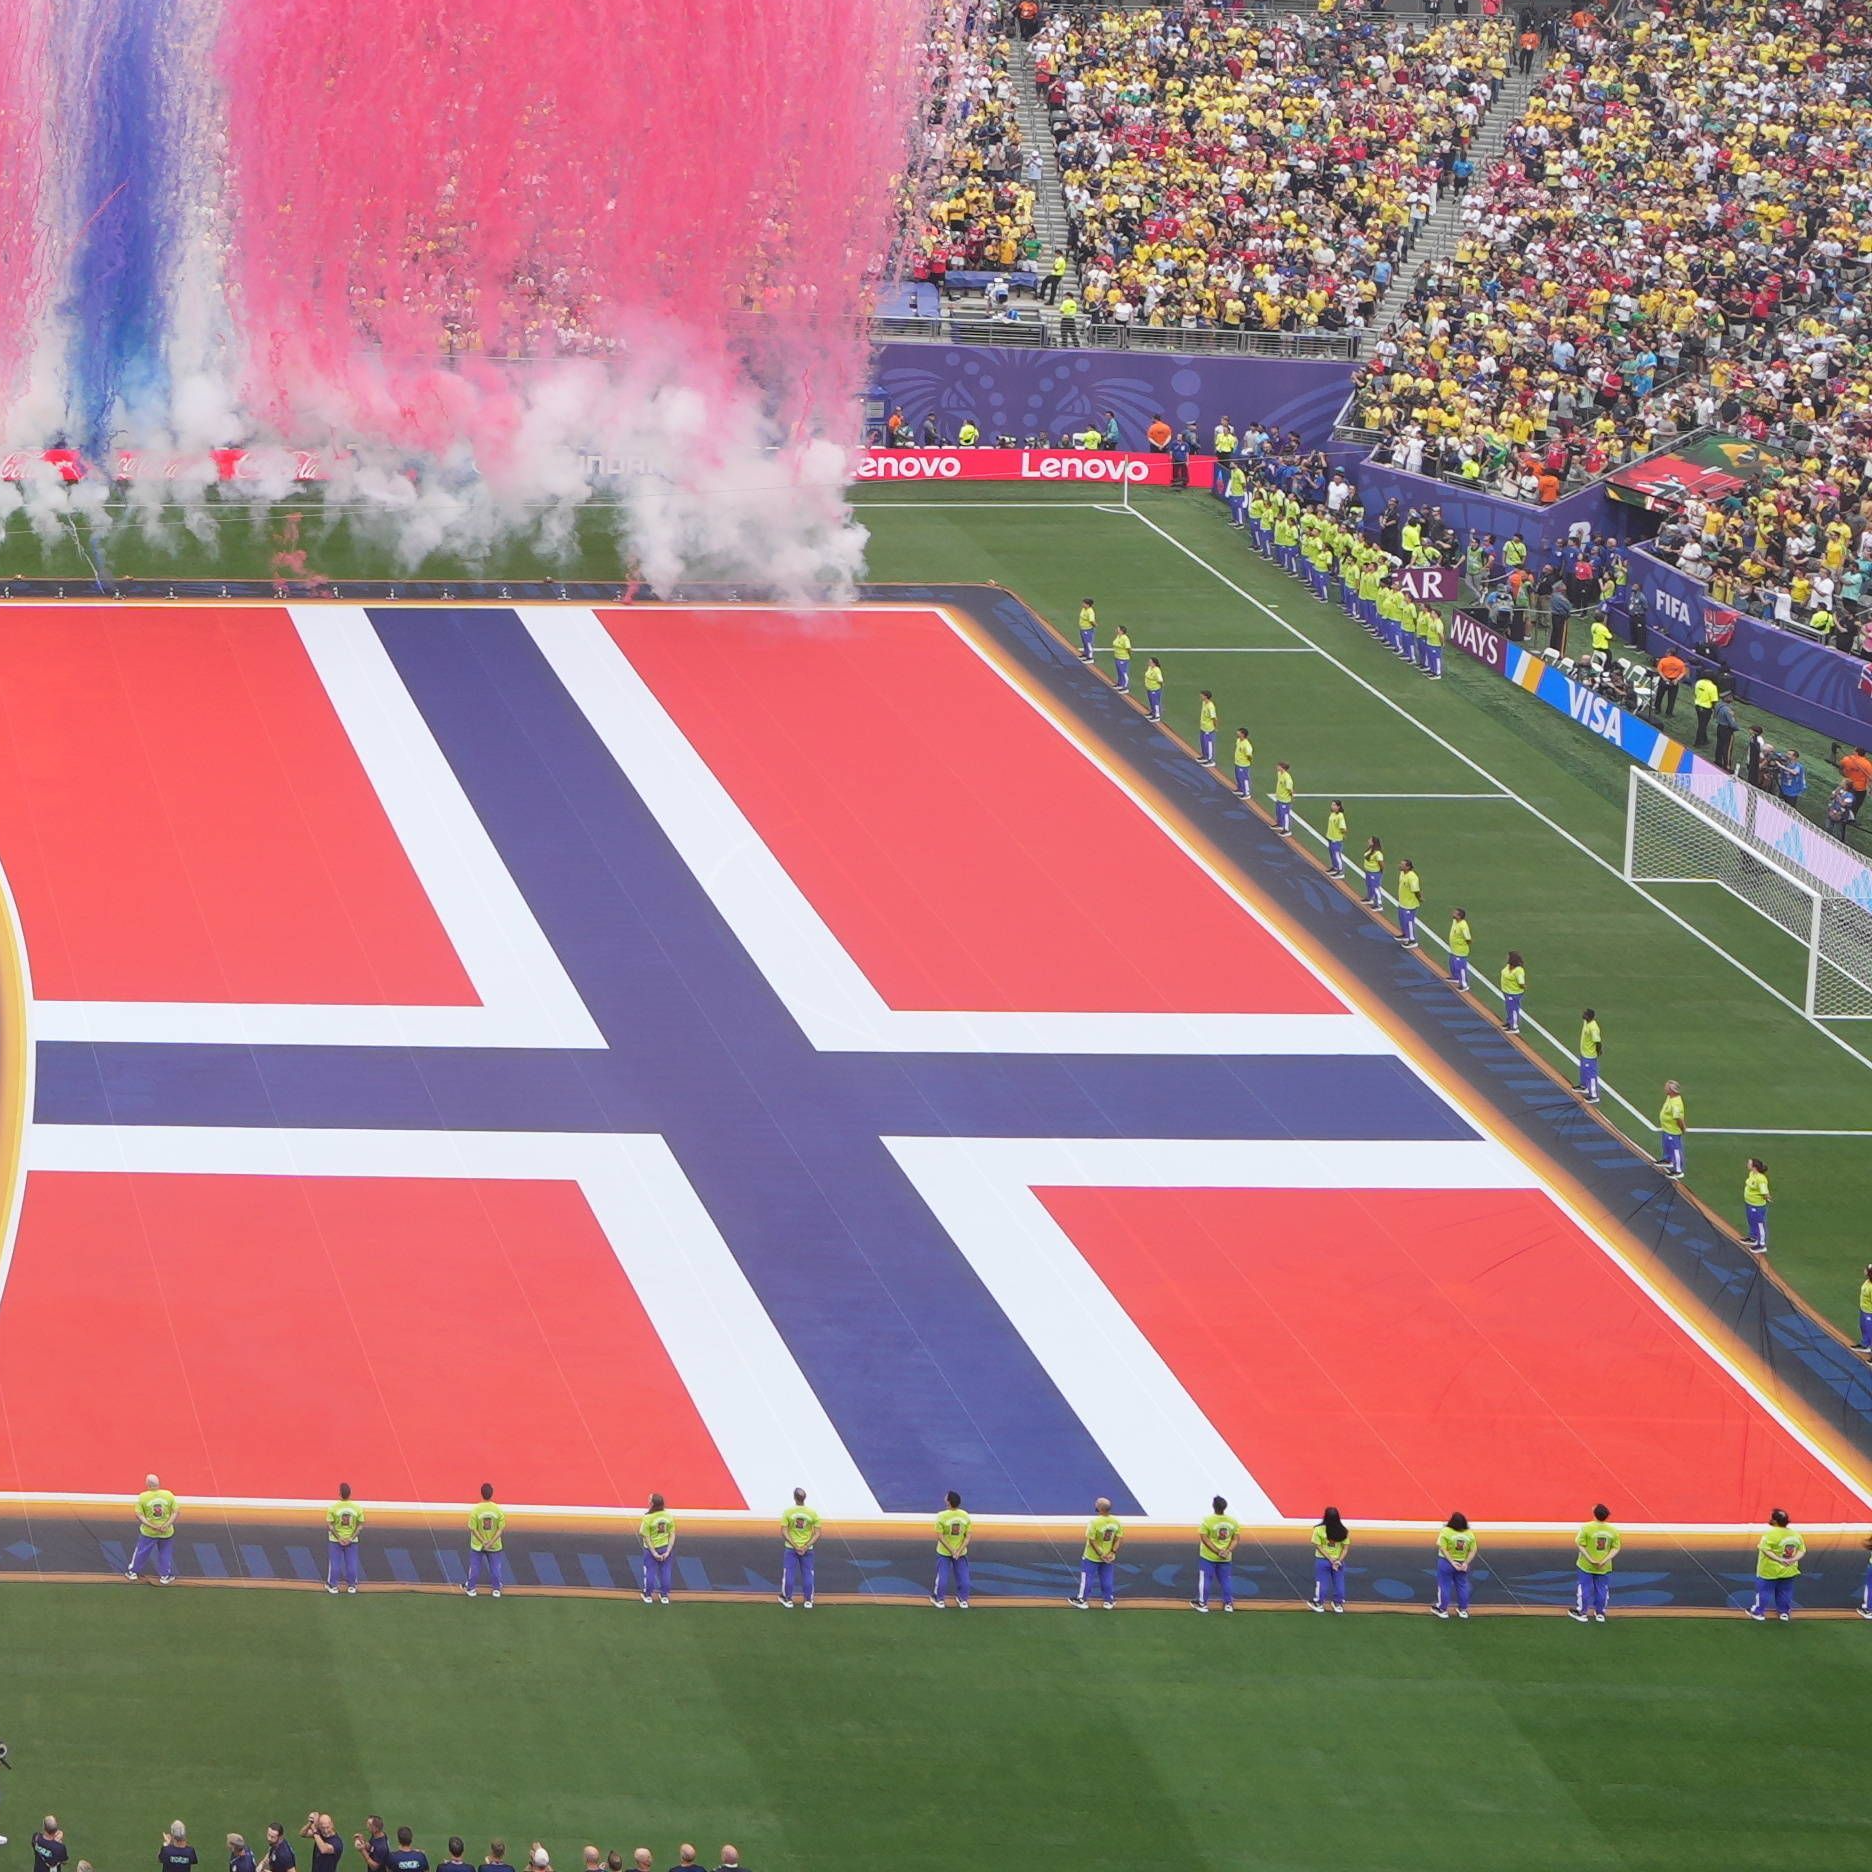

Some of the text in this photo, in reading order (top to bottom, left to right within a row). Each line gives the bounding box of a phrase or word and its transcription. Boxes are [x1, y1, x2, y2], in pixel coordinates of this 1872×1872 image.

[1020, 452, 1149, 482] Lenovo
[1656, 589, 1691, 626] FIFA
[1564, 677, 1622, 746] VISA
